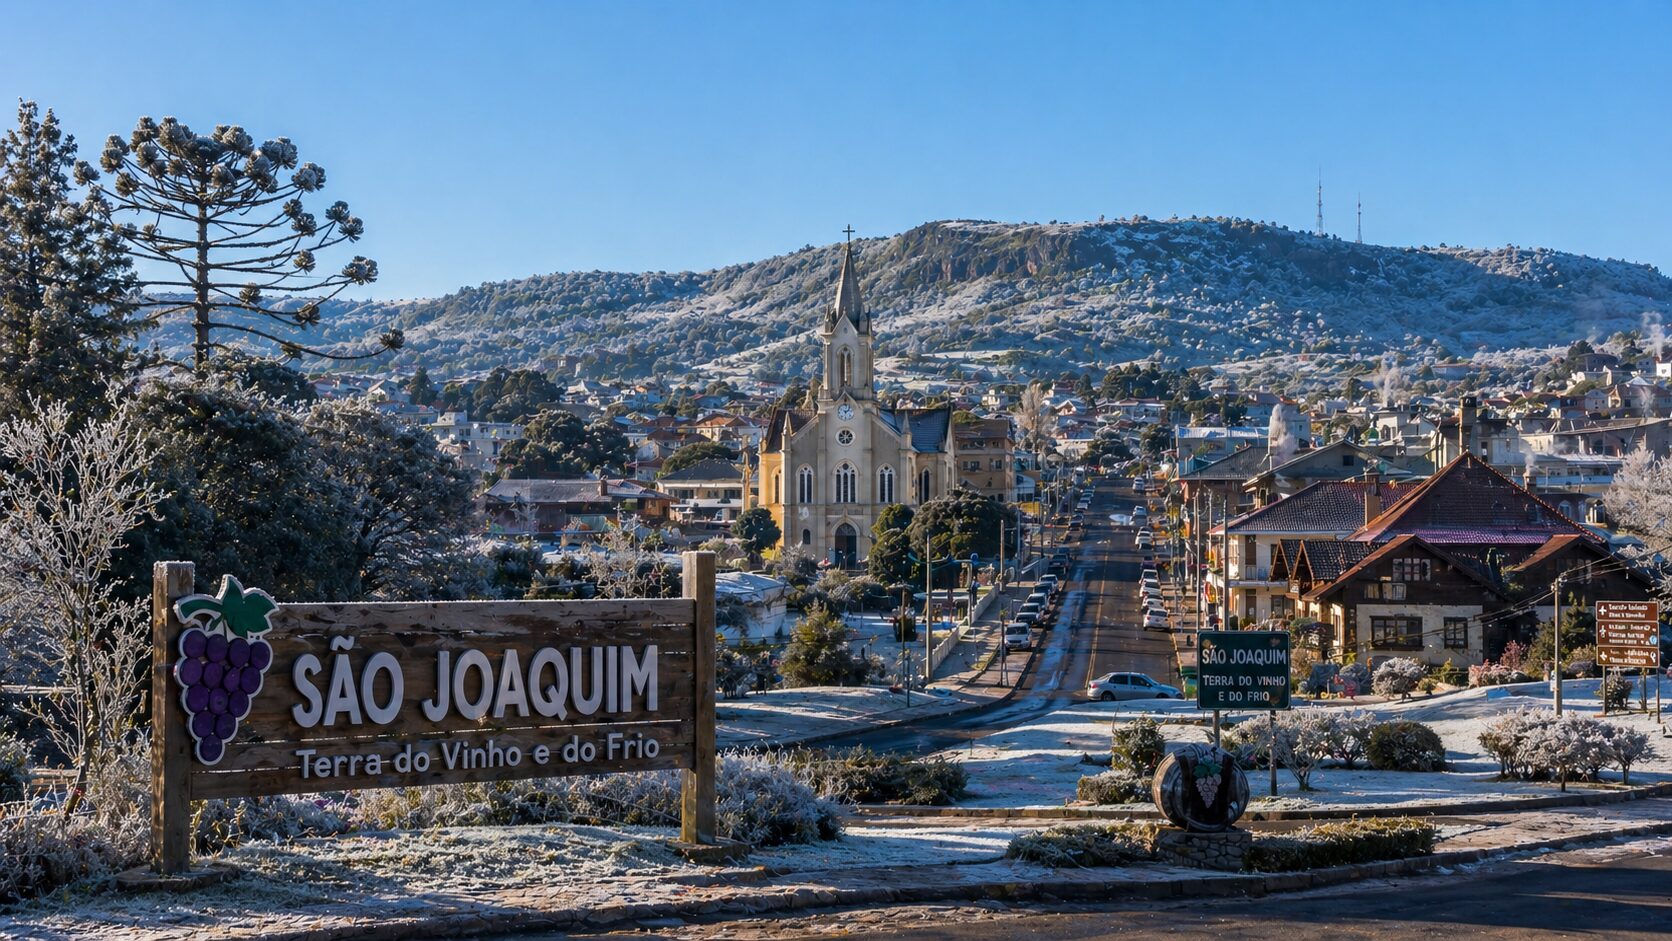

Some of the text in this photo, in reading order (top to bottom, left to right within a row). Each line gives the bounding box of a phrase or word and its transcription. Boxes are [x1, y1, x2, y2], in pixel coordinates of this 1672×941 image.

[1202, 645, 1286, 666] SÃO JOAQUIM
[292, 636, 658, 728] SÃO JOAQUIM
[1202, 675, 1286, 686] TERRA DO VINHO
[1218, 691, 1270, 701] E DO FRIO
[296, 732, 660, 779] Terra do Vinho e do Frio
